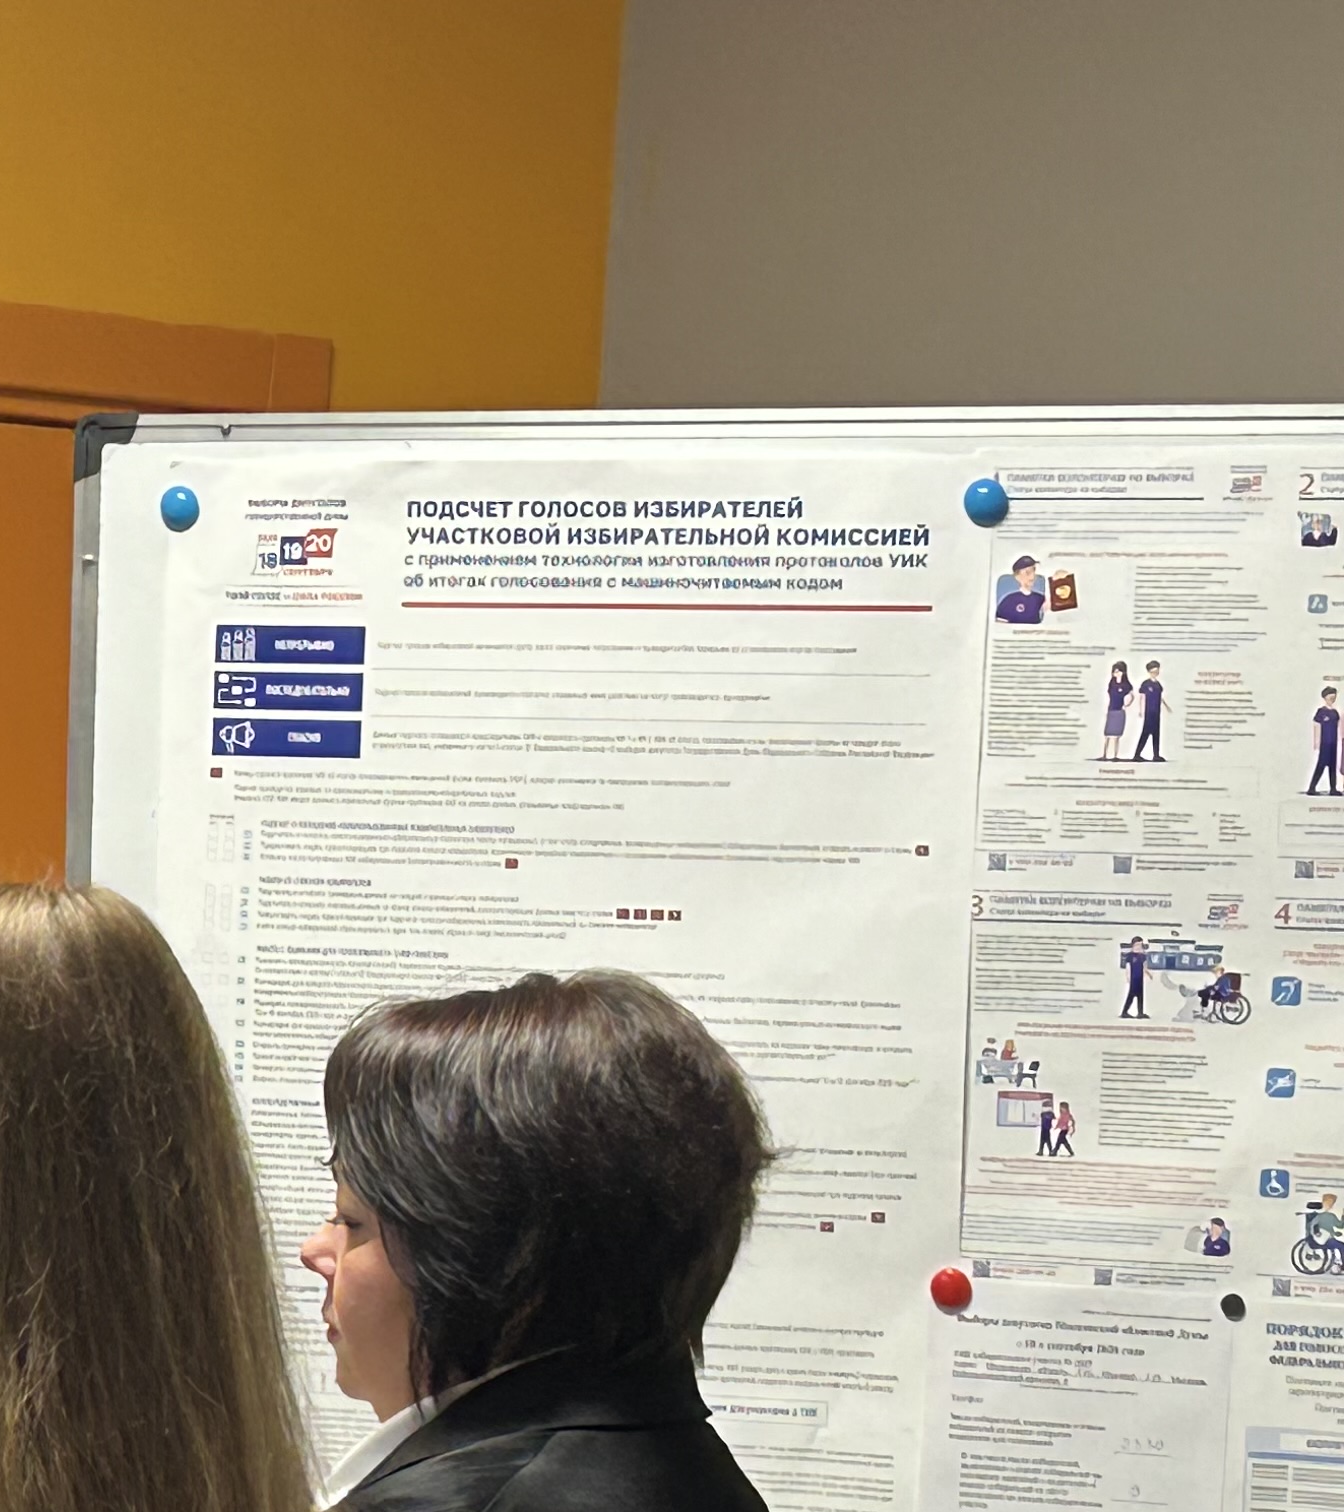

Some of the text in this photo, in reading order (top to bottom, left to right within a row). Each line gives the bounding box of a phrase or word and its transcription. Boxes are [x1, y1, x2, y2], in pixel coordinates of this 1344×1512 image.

[1299, 474, 1315, 495] 2
[406, 496, 803, 520] ПОДСЧЕТ ГОЛОСОВ ИЗБИРАТЕЛЕЙ
[406, 522, 930, 547] УЧАСТКОВОЙ ИЗБИРАТЕЛЬНОЙ КОМИССИЕЙ
[258, 534, 332, 569] 18 19 20
[889, 554, 929, 568] УИК
[403, 574, 424, 588] об
[786, 578, 843, 592] кодом
[971, 895, 983, 916] 3
[1274, 903, 1292, 925] 4
